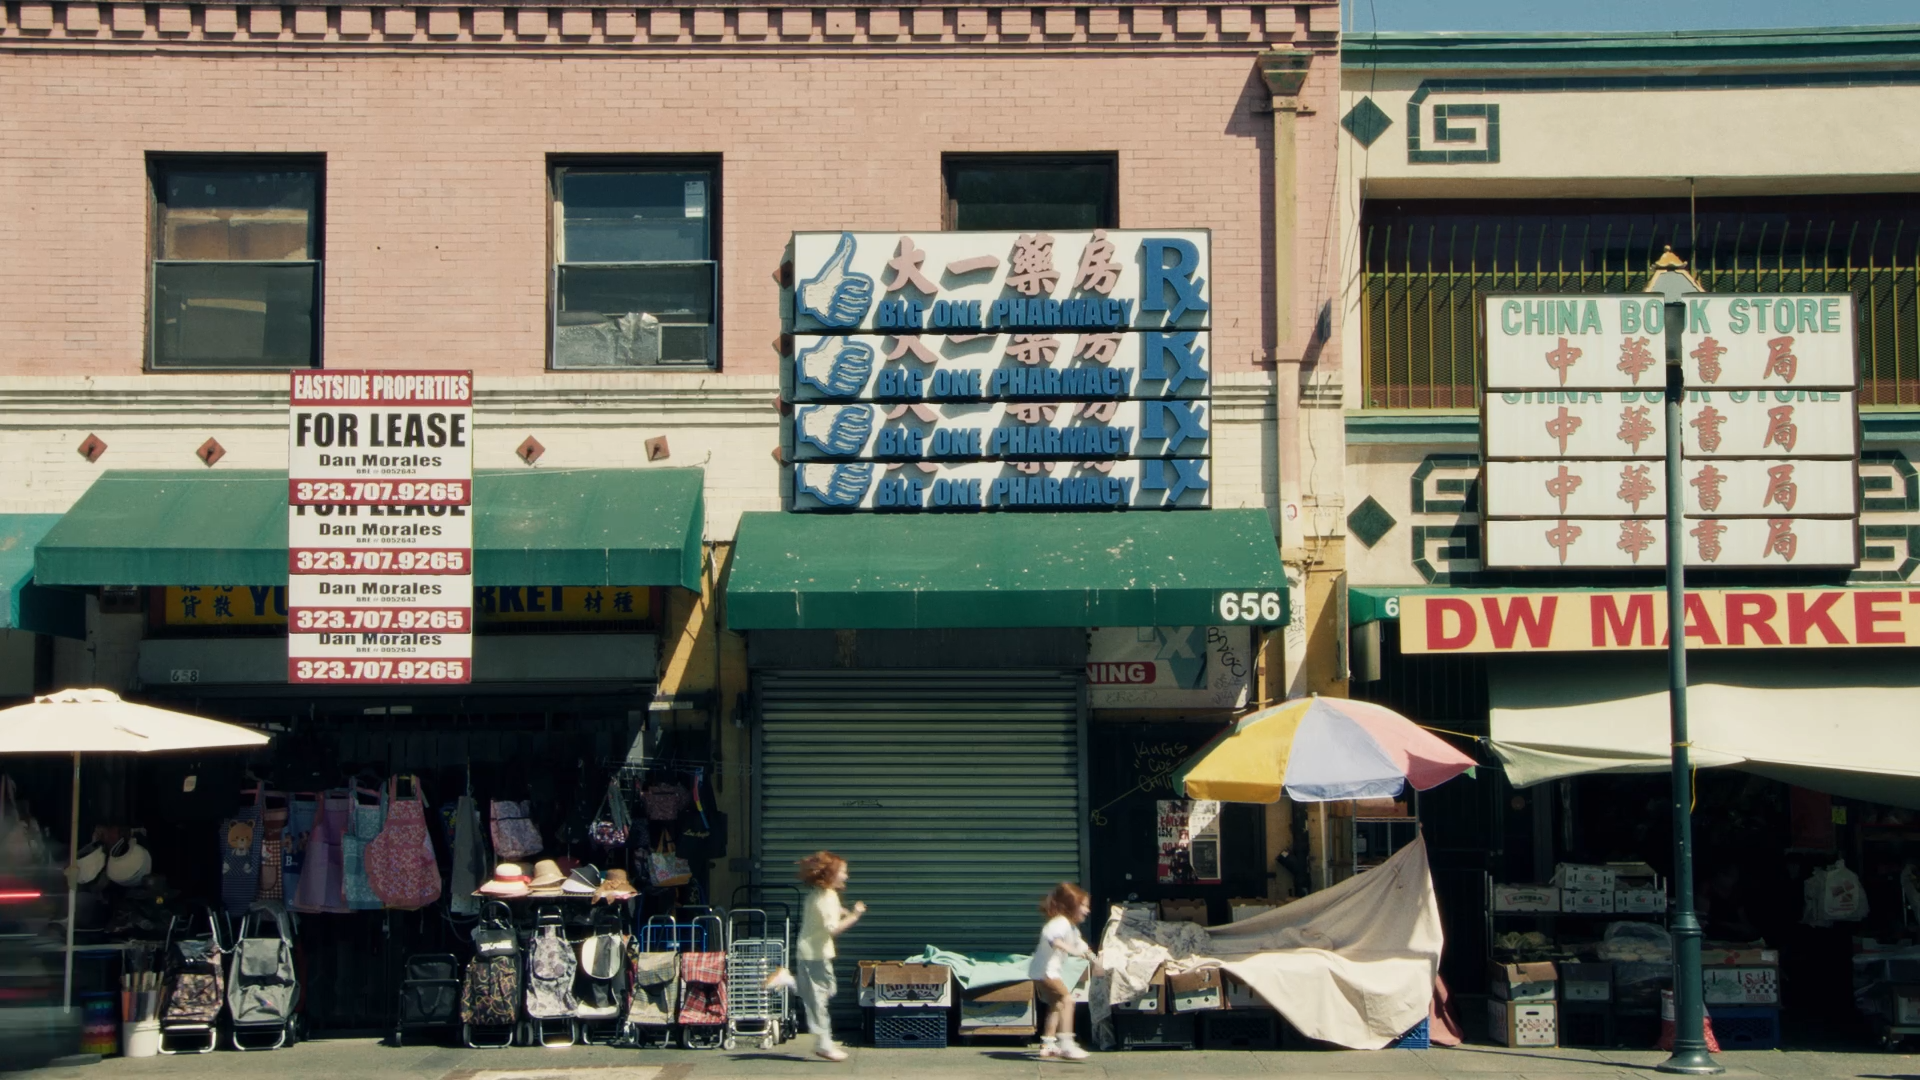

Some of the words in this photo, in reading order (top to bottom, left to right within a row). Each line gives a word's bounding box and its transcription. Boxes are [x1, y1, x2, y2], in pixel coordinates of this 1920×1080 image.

[886, 229, 1123, 296] 大一藥房
[880, 300, 924, 327] BIG
[933, 300, 982, 327] ONE
[992, 298, 1134, 326] PHARMACY
[1501, 299, 1603, 335] CHINA
[1620, 299, 1711, 335] BOK
[1728, 298, 1841, 335] STORE
[1545, 336, 1798, 387] 中華書局
[294, 375, 370, 400] EASTSIDE
[373, 375, 470, 400] PROPERTIES
[880, 369, 924, 396] BIG
[933, 369, 982, 396] ONE
[992, 367, 1134, 395] PHARMACY
[297, 412, 359, 447] FOR
[370, 412, 466, 447] LEASE
[880, 428, 924, 456] BIG
[933, 428, 982, 456] ONE
[992, 426, 1134, 454] PHARMACY
[1545, 405, 1798, 455] 中華書局
[319, 454, 356, 466] Dan
[362, 454, 442, 466] Morales
[297, 483, 464, 501] 323.707.9265
[880, 478, 924, 506] BIG
[933, 478, 982, 506] ONE
[992, 476, 1134, 505] PHARMACY
[1545, 464, 1798, 516] 中華書局
[319, 523, 356, 536] Dan
[362, 523, 442, 536] Morales
[1545, 519, 1798, 566] 中華書局
[297, 552, 464, 570] 323.707.9265
[319, 582, 356, 595] Dan
[362, 582, 442, 595] Morales
[297, 611, 464, 629] 323.707.9265
[1219, 592, 1281, 621] 656
[1425, 596, 1558, 651] DW
[319, 633, 356, 646] Dan
[362, 633, 442, 646] Morales
[171, 670, 198, 682] 658
[297, 661, 464, 679] 323.707.9265
